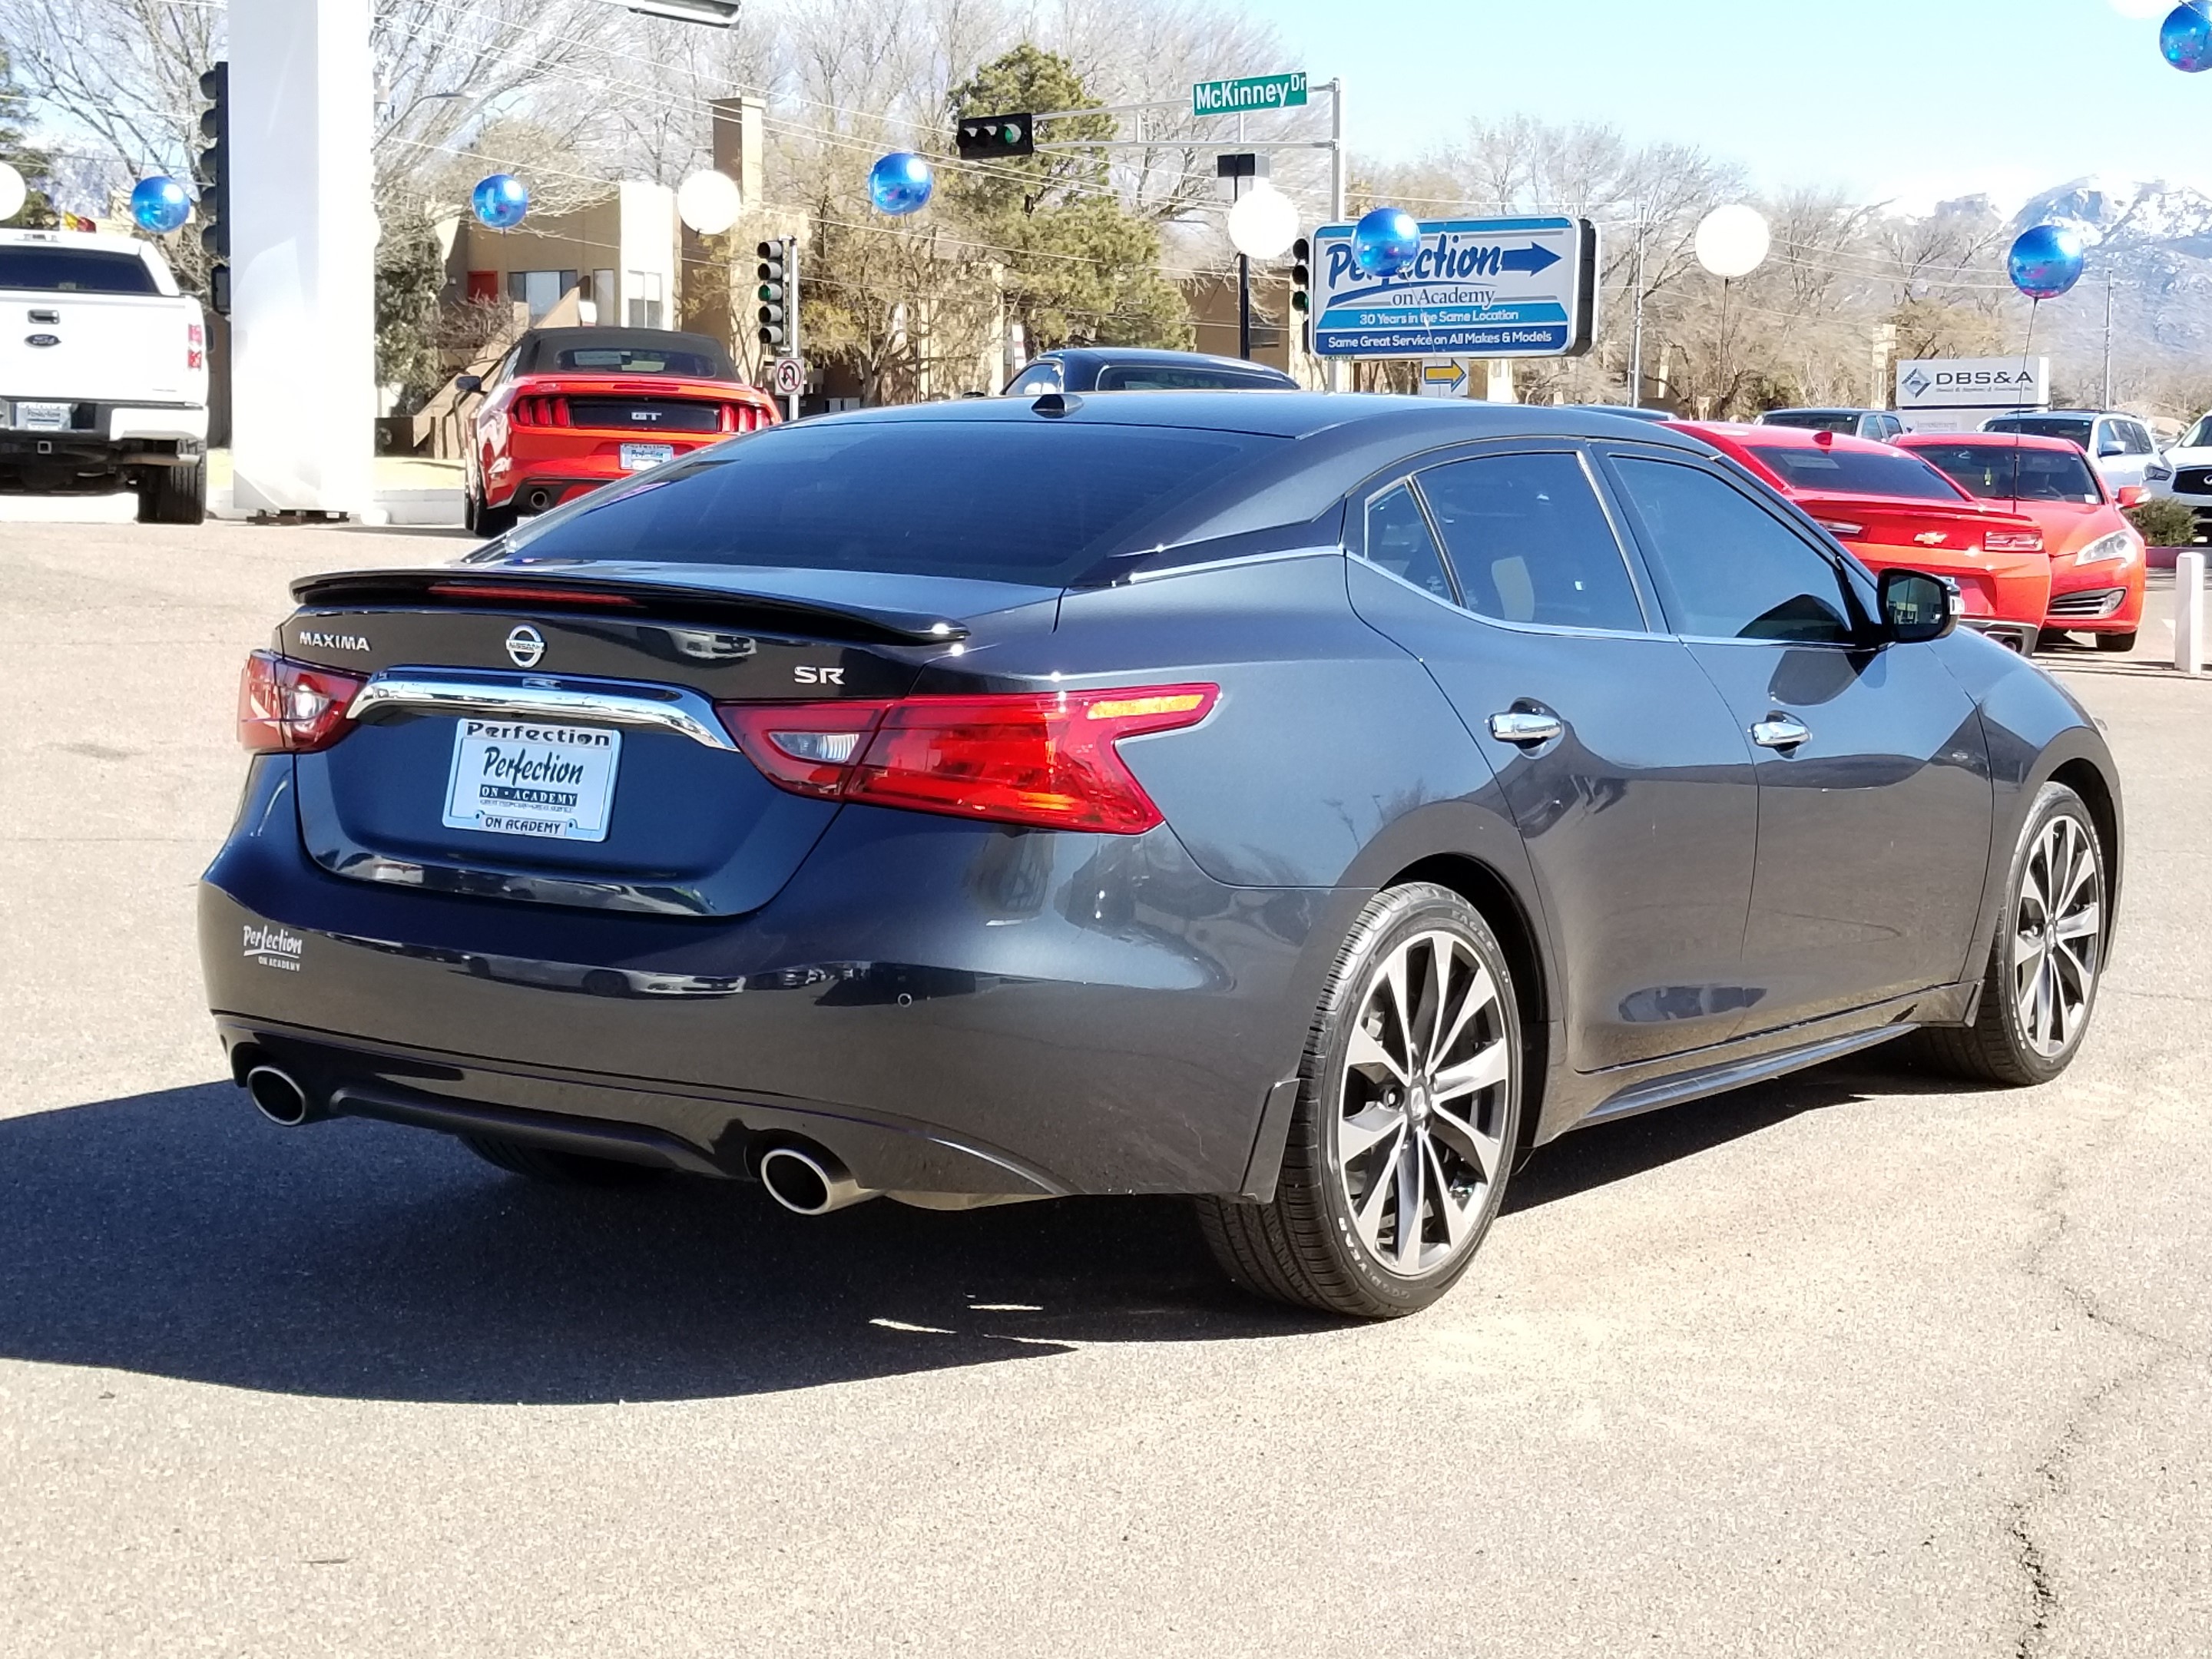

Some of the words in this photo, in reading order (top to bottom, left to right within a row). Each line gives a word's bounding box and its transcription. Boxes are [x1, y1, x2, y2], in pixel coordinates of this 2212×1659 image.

[1196, 81, 1289, 110] McKinney
[1290, 74, 1306, 91] Dr
[1326, 233, 1502, 290] Pection
[1392, 291, 1413, 306] on
[1418, 287, 1495, 309] Academy
[1359, 313, 1376, 325] 30
[1376, 313, 1407, 324] Years
[1408, 312, 1419, 323] in
[1439, 310, 1471, 323] Same
[1472, 310, 1519, 322] Location
[1328, 336, 1359, 348] Same
[1359, 336, 1391, 347] Great
[1392, 334, 1432, 346] Service
[1433, 335, 1448, 345] on
[1449, 333, 1464, 344] All
[1465, 332, 1500, 344] Makes
[1502, 332, 1511, 343] &
[1512, 330, 1552, 343] Models
[1936, 372, 2034, 385] DBS&A
[631, 412, 662, 421] GT
[299, 631, 370, 652] MAXIMA
[794, 666, 846, 685] SR
[466, 721, 610, 747] Perfection
[482, 746, 584, 786] Perfection
[482, 786, 499, 797] ON
[513, 790, 577, 805] ACADEMY
[485, 816, 502, 830] ON
[505, 819, 561, 835] ACADEMY
[243, 925, 303, 955] Perfection
